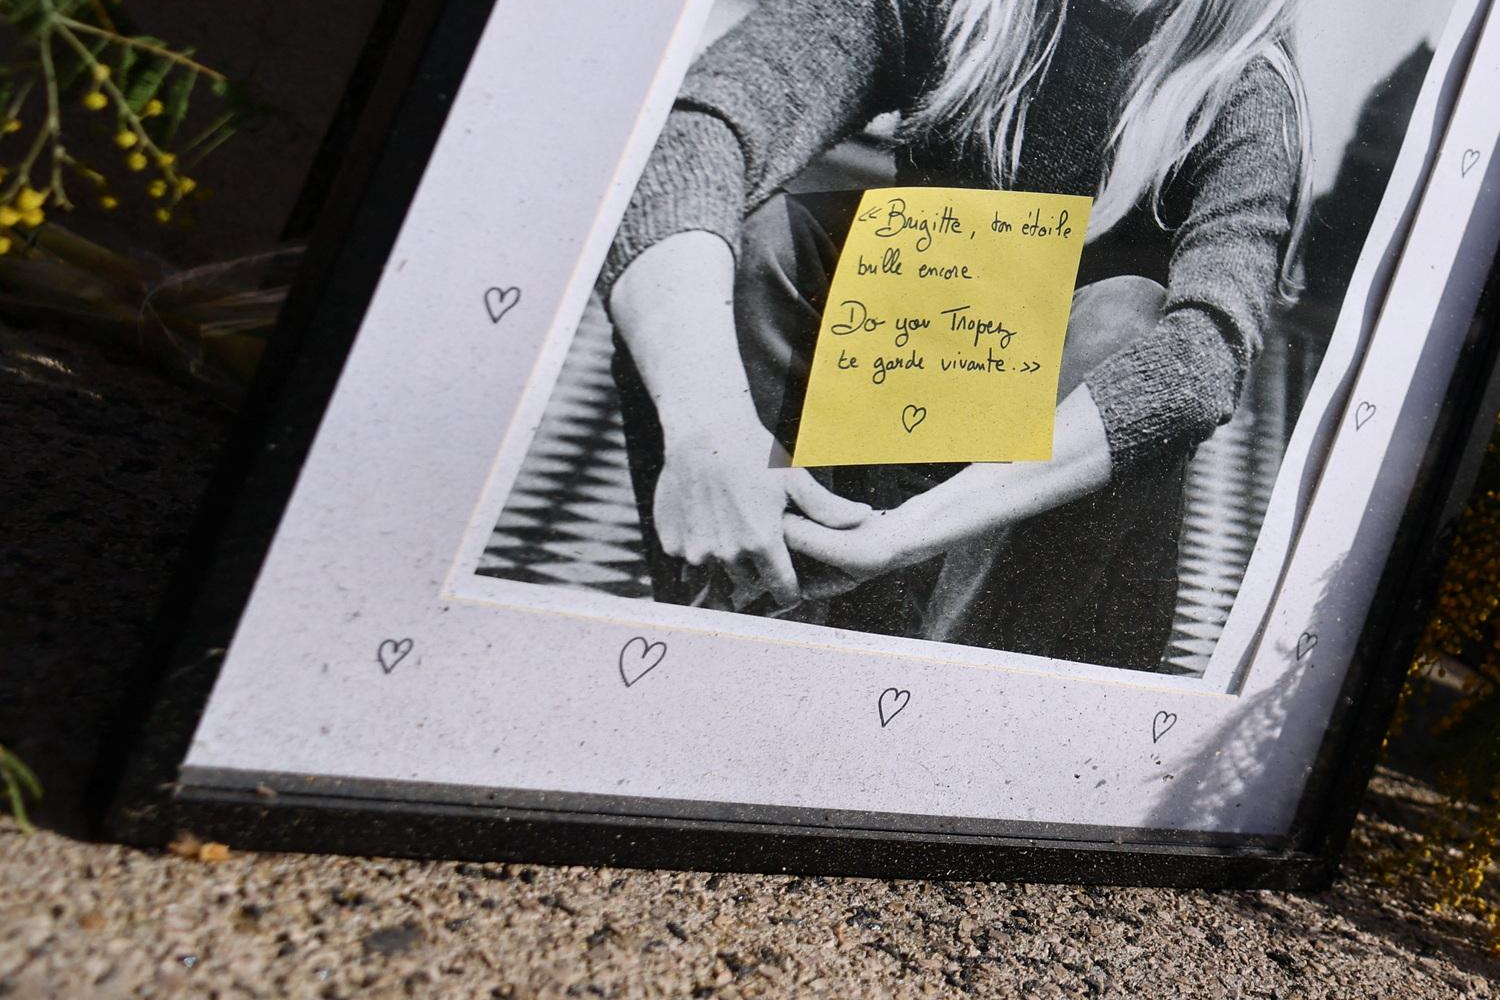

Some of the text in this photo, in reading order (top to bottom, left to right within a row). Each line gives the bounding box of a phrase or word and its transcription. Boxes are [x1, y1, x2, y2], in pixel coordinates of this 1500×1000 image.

[1021, 208, 1073, 239] étoile
[857, 247, 904, 275] brille
[830, 300, 1018, 349] Do you Tropez
[838, 349, 860, 370] te
[871, 349, 925, 385] garde
